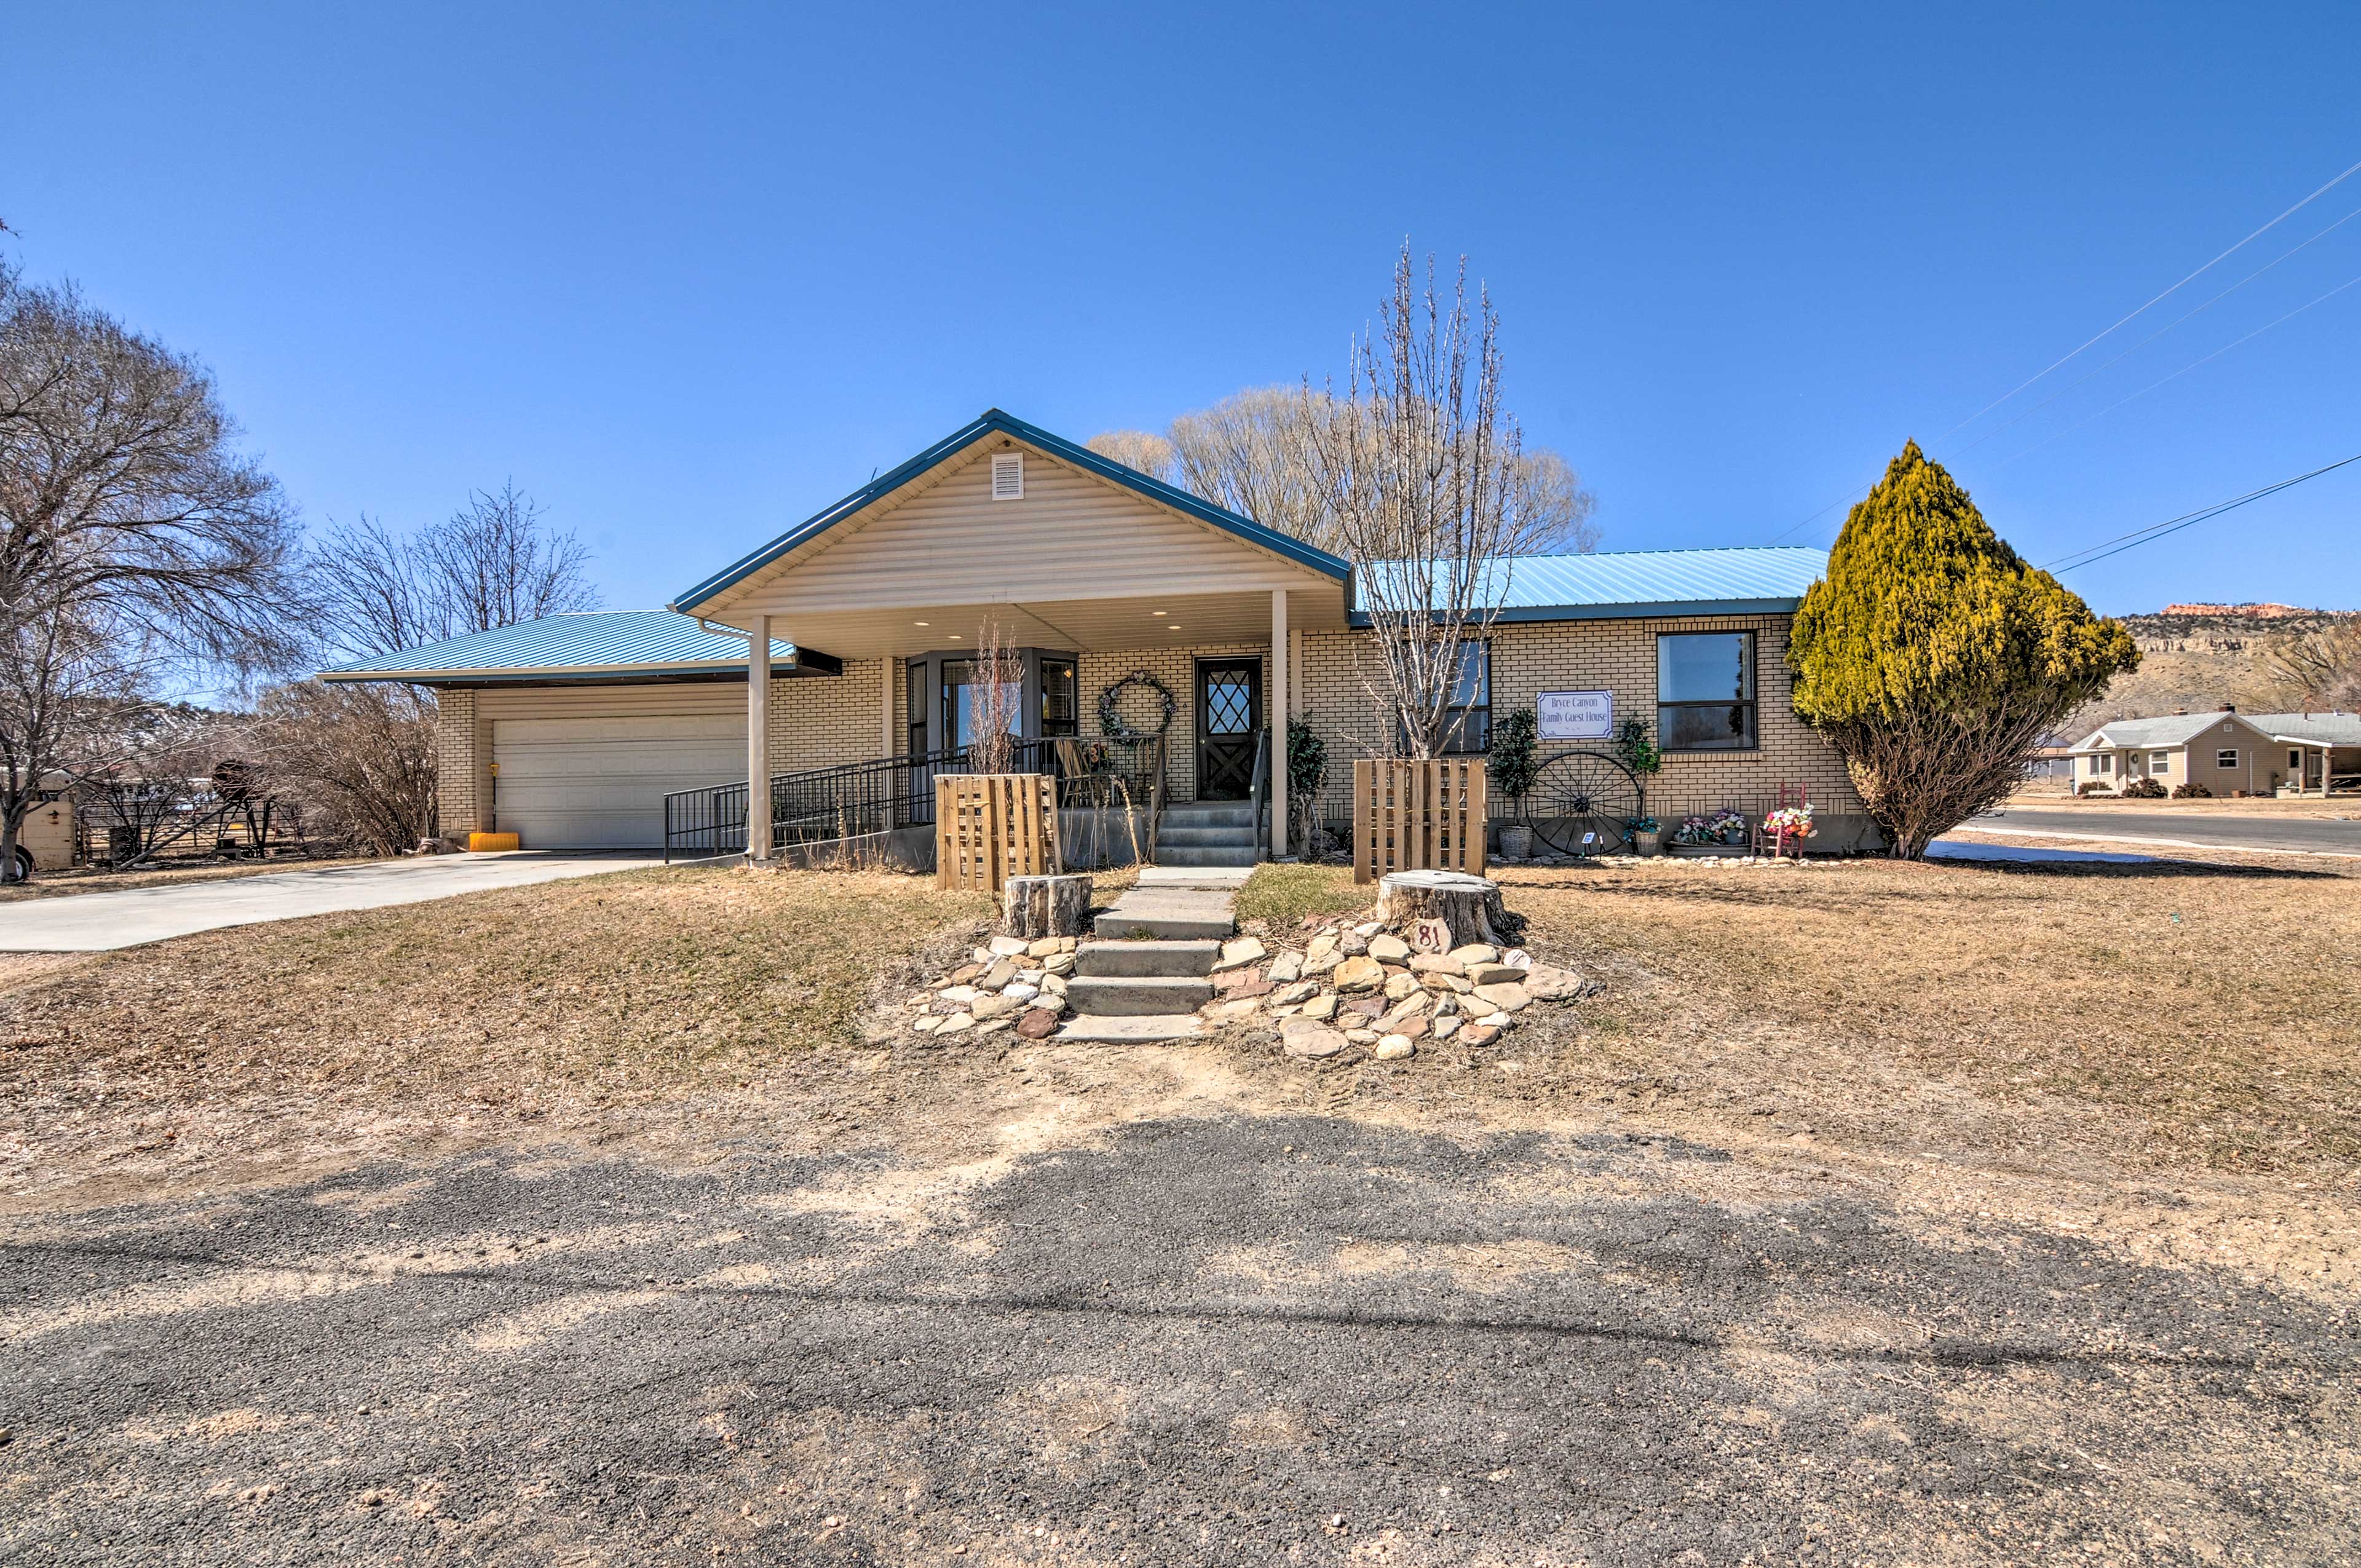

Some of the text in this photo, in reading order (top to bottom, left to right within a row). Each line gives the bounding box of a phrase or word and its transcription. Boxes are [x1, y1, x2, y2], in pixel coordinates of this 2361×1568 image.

[1552, 697, 1597, 709] Bryce Canyon
[1543, 711, 1607, 724] Family Guest House
[1419, 925, 1440, 946] 81
